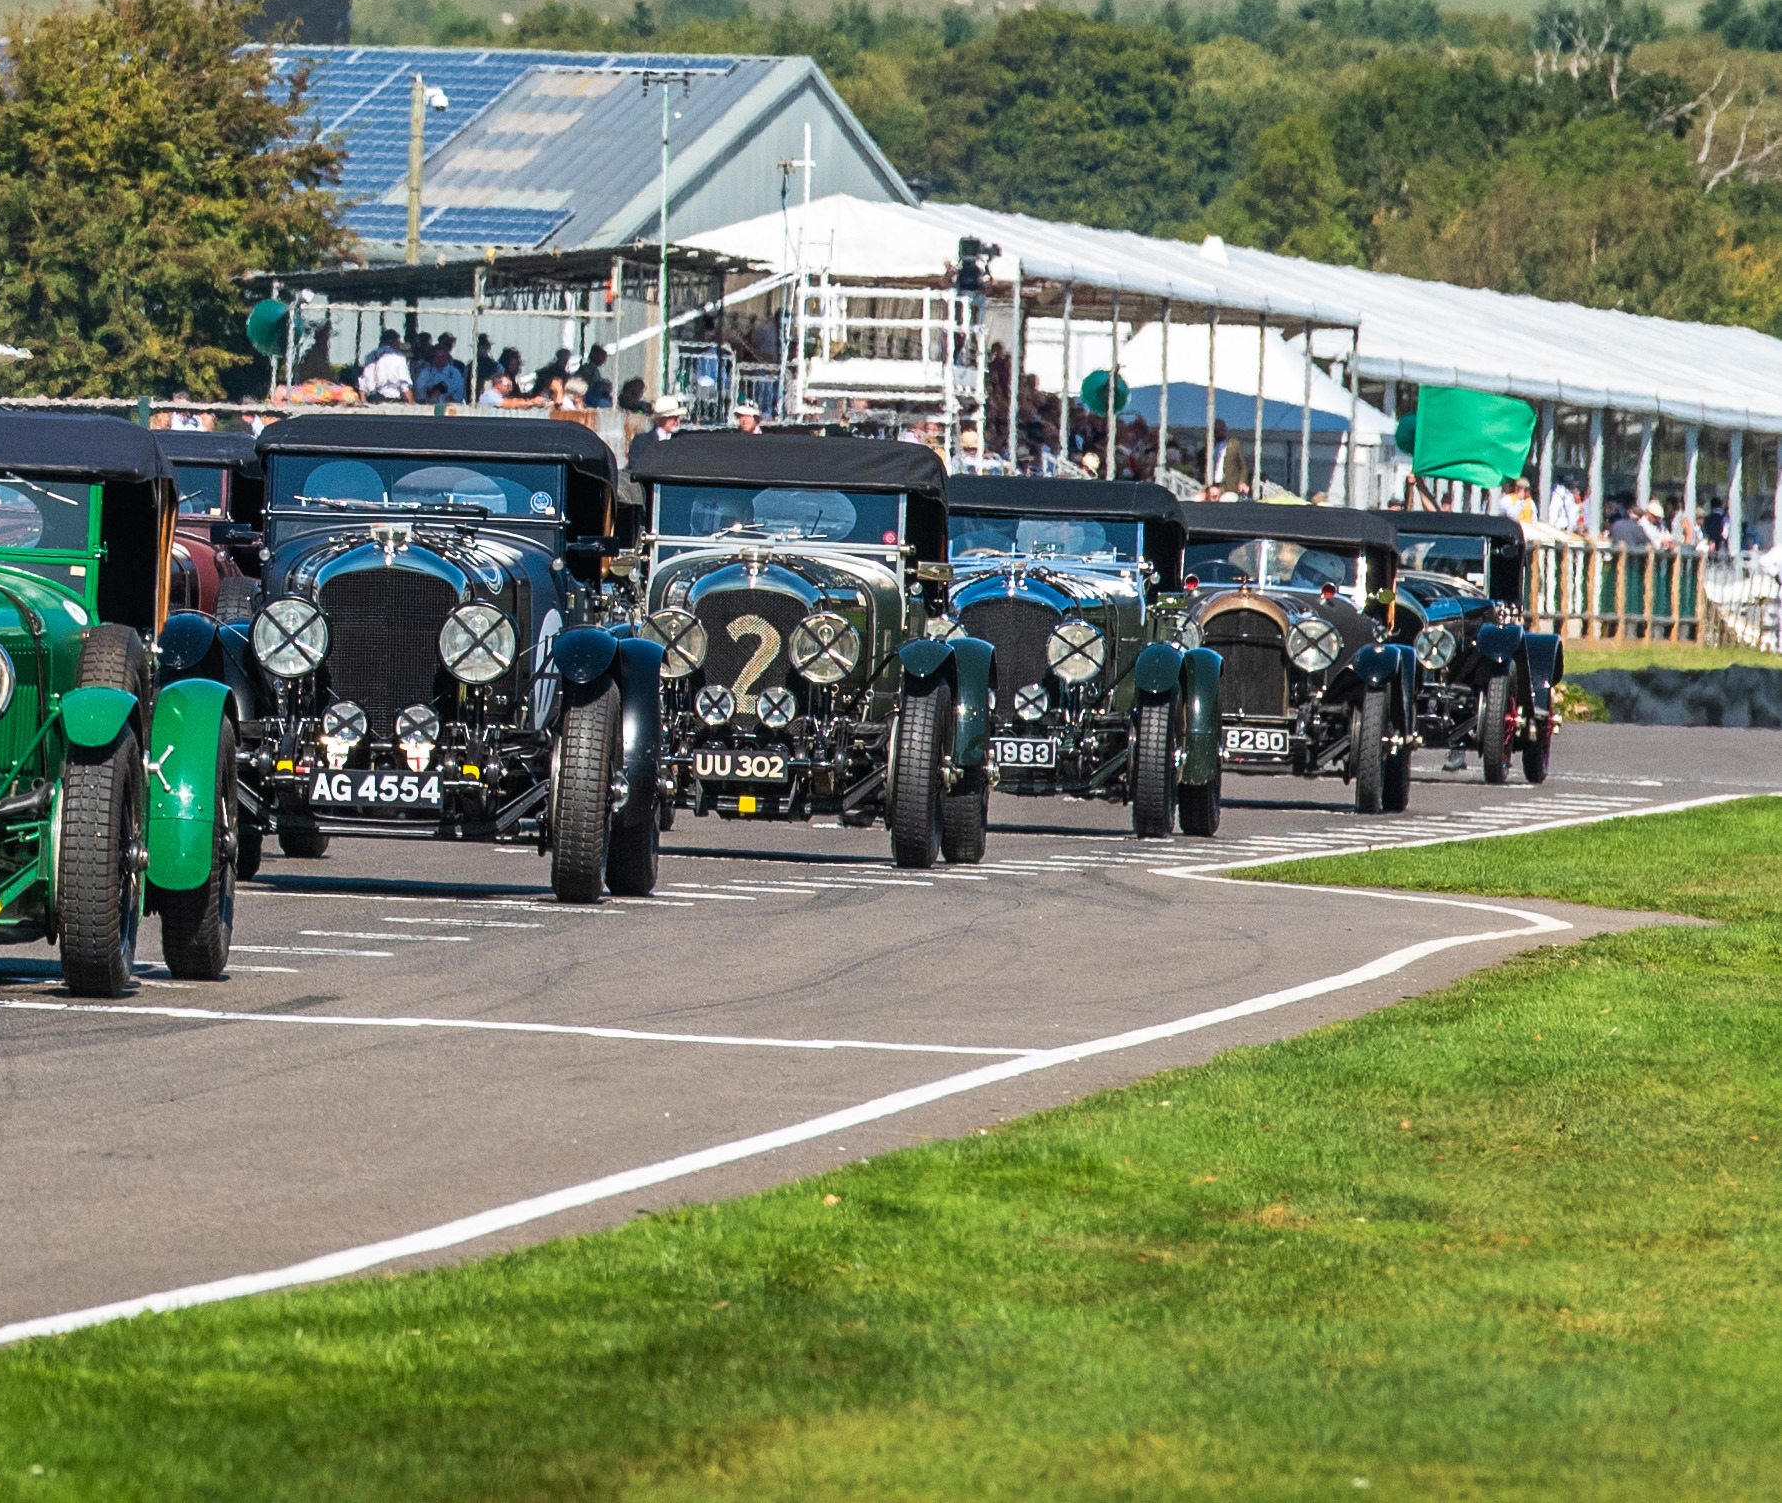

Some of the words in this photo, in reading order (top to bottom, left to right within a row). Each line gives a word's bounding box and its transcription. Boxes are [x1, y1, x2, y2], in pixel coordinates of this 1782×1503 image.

[726, 614, 782, 715] 2
[1227, 730, 1284, 751] 8280
[696, 754, 731, 777] UU
[735, 754, 784, 778] 302
[312, 772, 352, 802] AG
[357, 774, 441, 804] 4554
